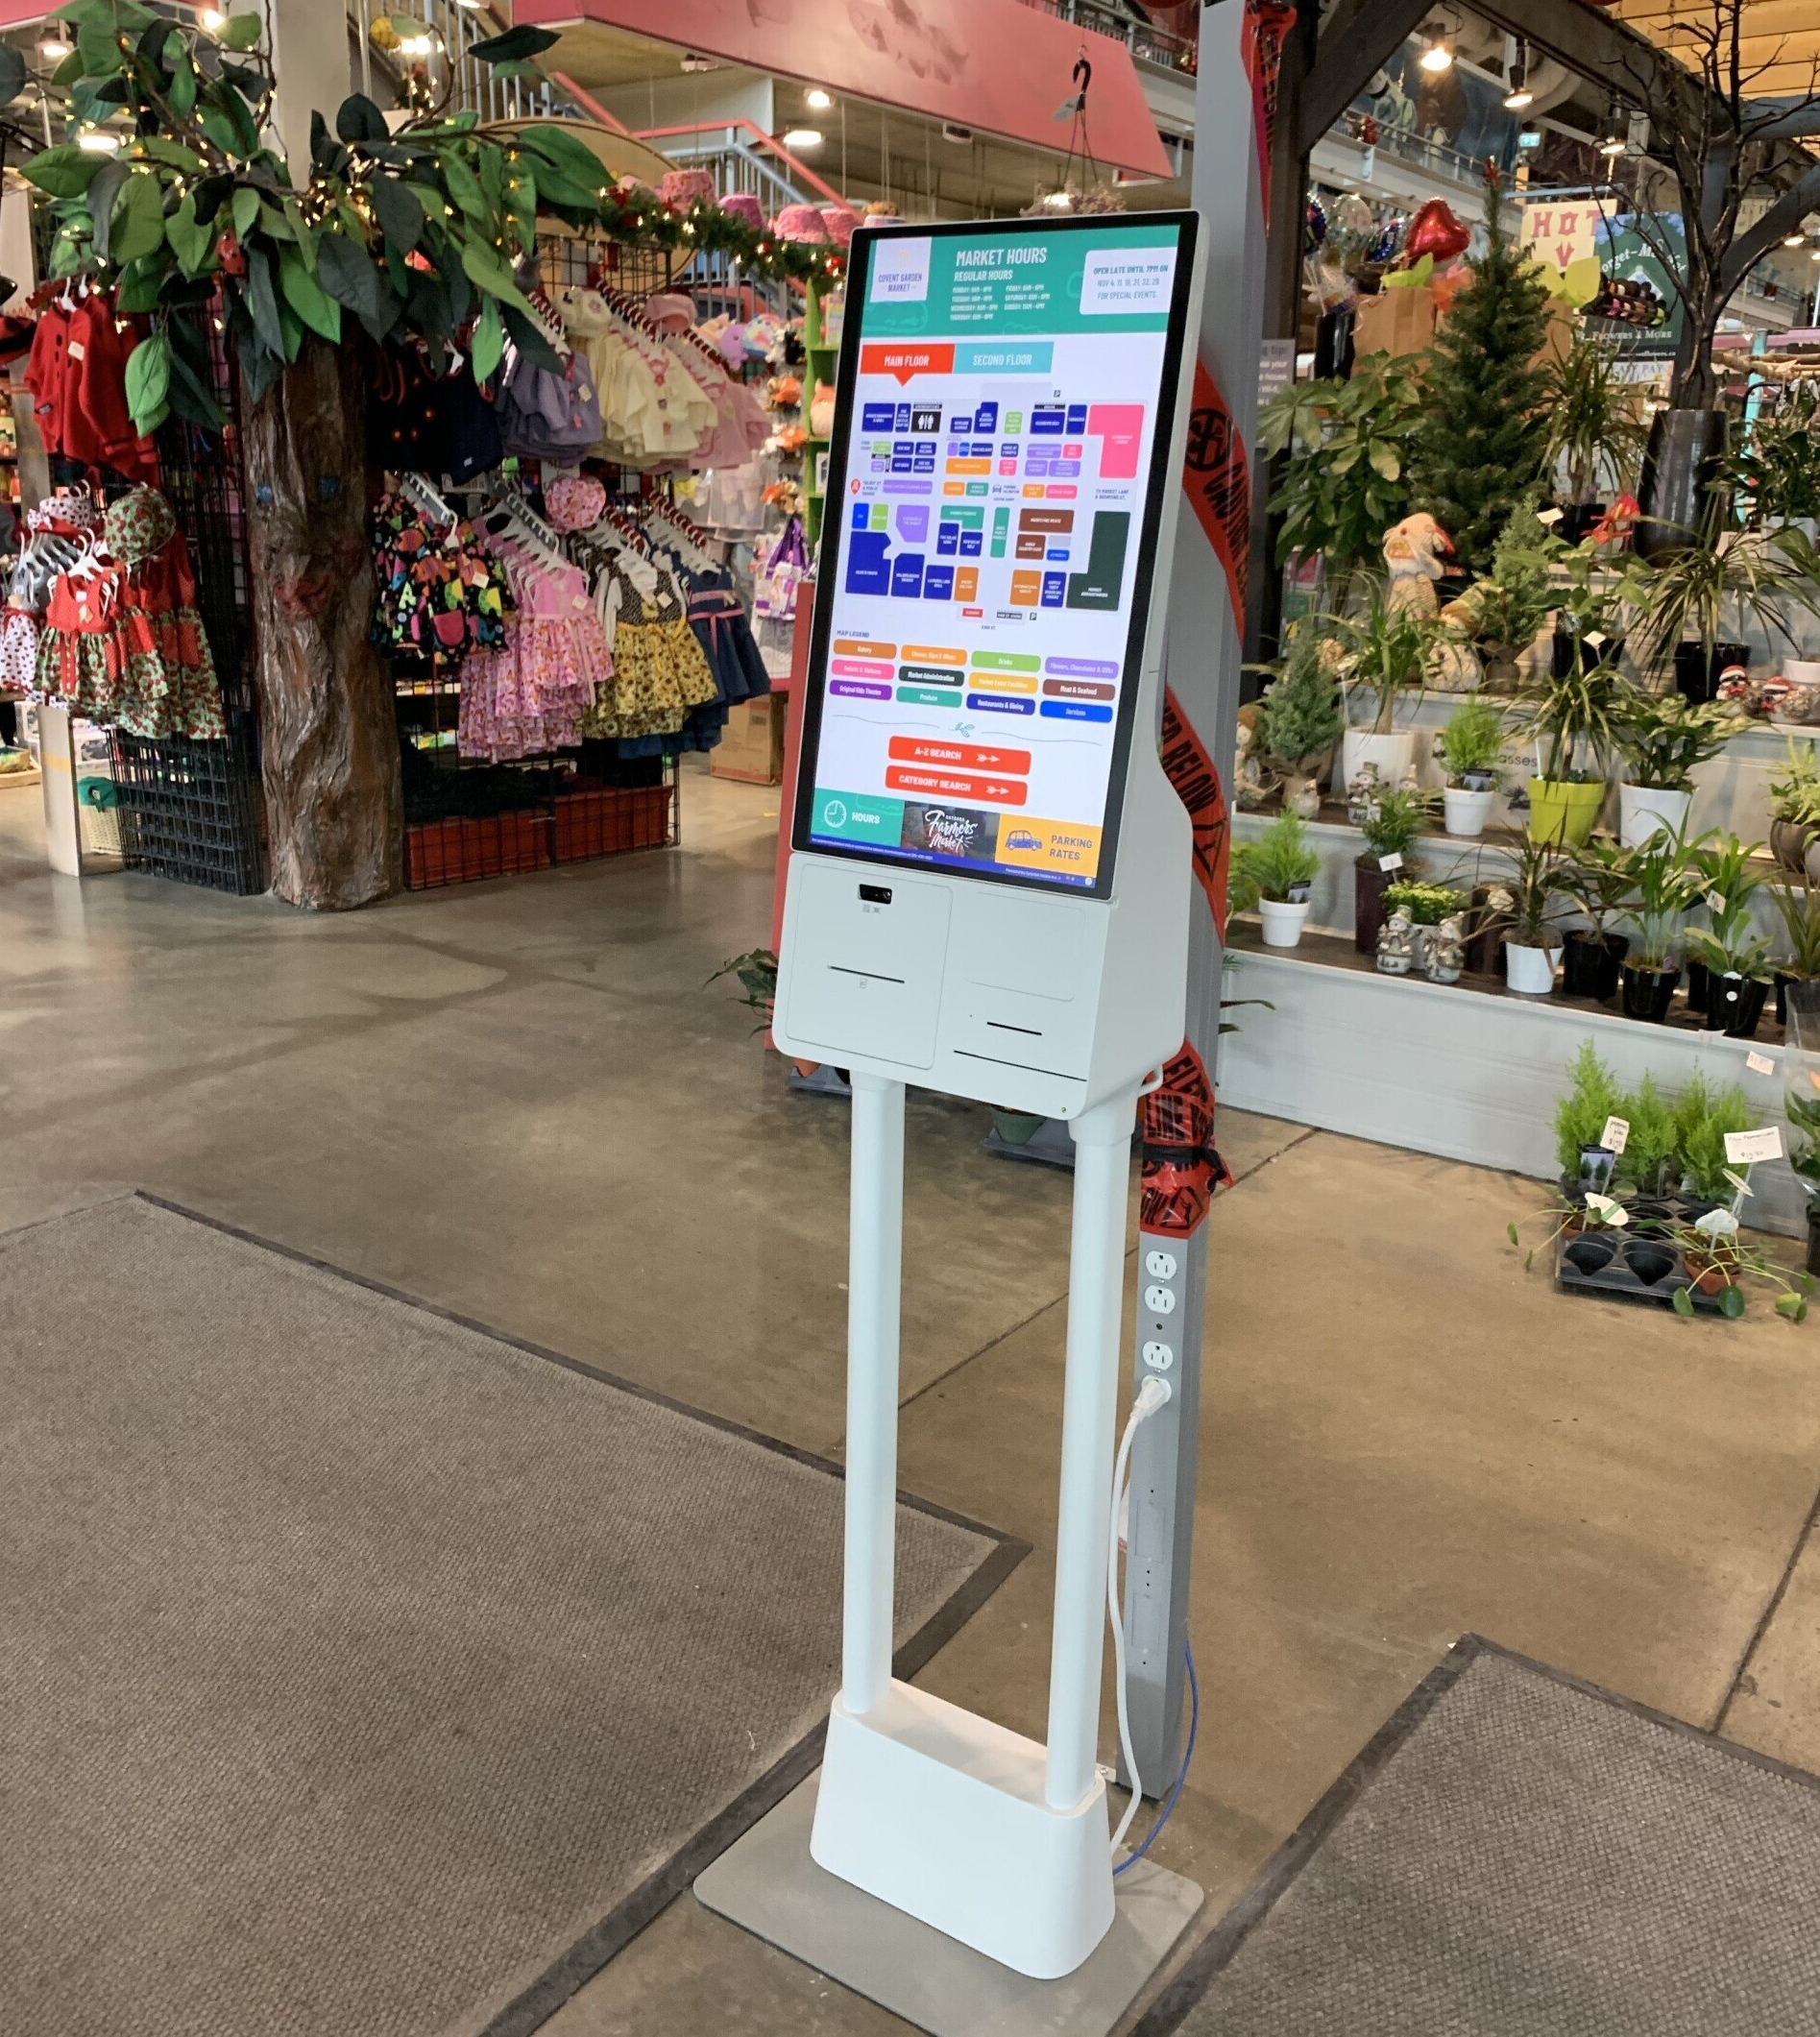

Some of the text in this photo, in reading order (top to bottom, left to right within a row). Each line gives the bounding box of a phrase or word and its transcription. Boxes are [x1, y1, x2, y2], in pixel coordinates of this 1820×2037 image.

[1532, 208, 1602, 238] HOT
[956, 247, 1048, 267] MARKET HOURS
[954, 269, 1013, 282] REGULAR HOURS
[1109, 266, 1127, 275] LATE
[1146, 265, 1159, 274] 7PM
[878, 273, 923, 283] COVENT GARDEN
[887, 283, 910, 293] MARKET
[1109, 291, 1131, 300] SPECIAL
[884, 354, 930, 367] MAIN FLOOR
[973, 353, 1032, 367] SECOND FLOOR
[908, 670, 955, 682] Market Administration
[839, 685, 856, 693] Original
[865, 688, 882, 696] Theatre
[1059, 685, 1072, 693] Meat
[1077, 687, 1098, 696] Seafood
[919, 693, 938, 702] Produce
[977, 699, 1005, 709] Restaurants
[1009, 701, 1025, 712] Dining
[914, 747, 961, 761] A-Z SEARCH
[1497, 754, 1538, 766] asses
[898, 775, 972, 792] CATEGORY SEARCH
[851, 812, 881, 825] HOURS
[929, 833, 963, 853] Market
[1051, 835, 1093, 849] PARKING
[1049, 848, 1080, 861] RATES
